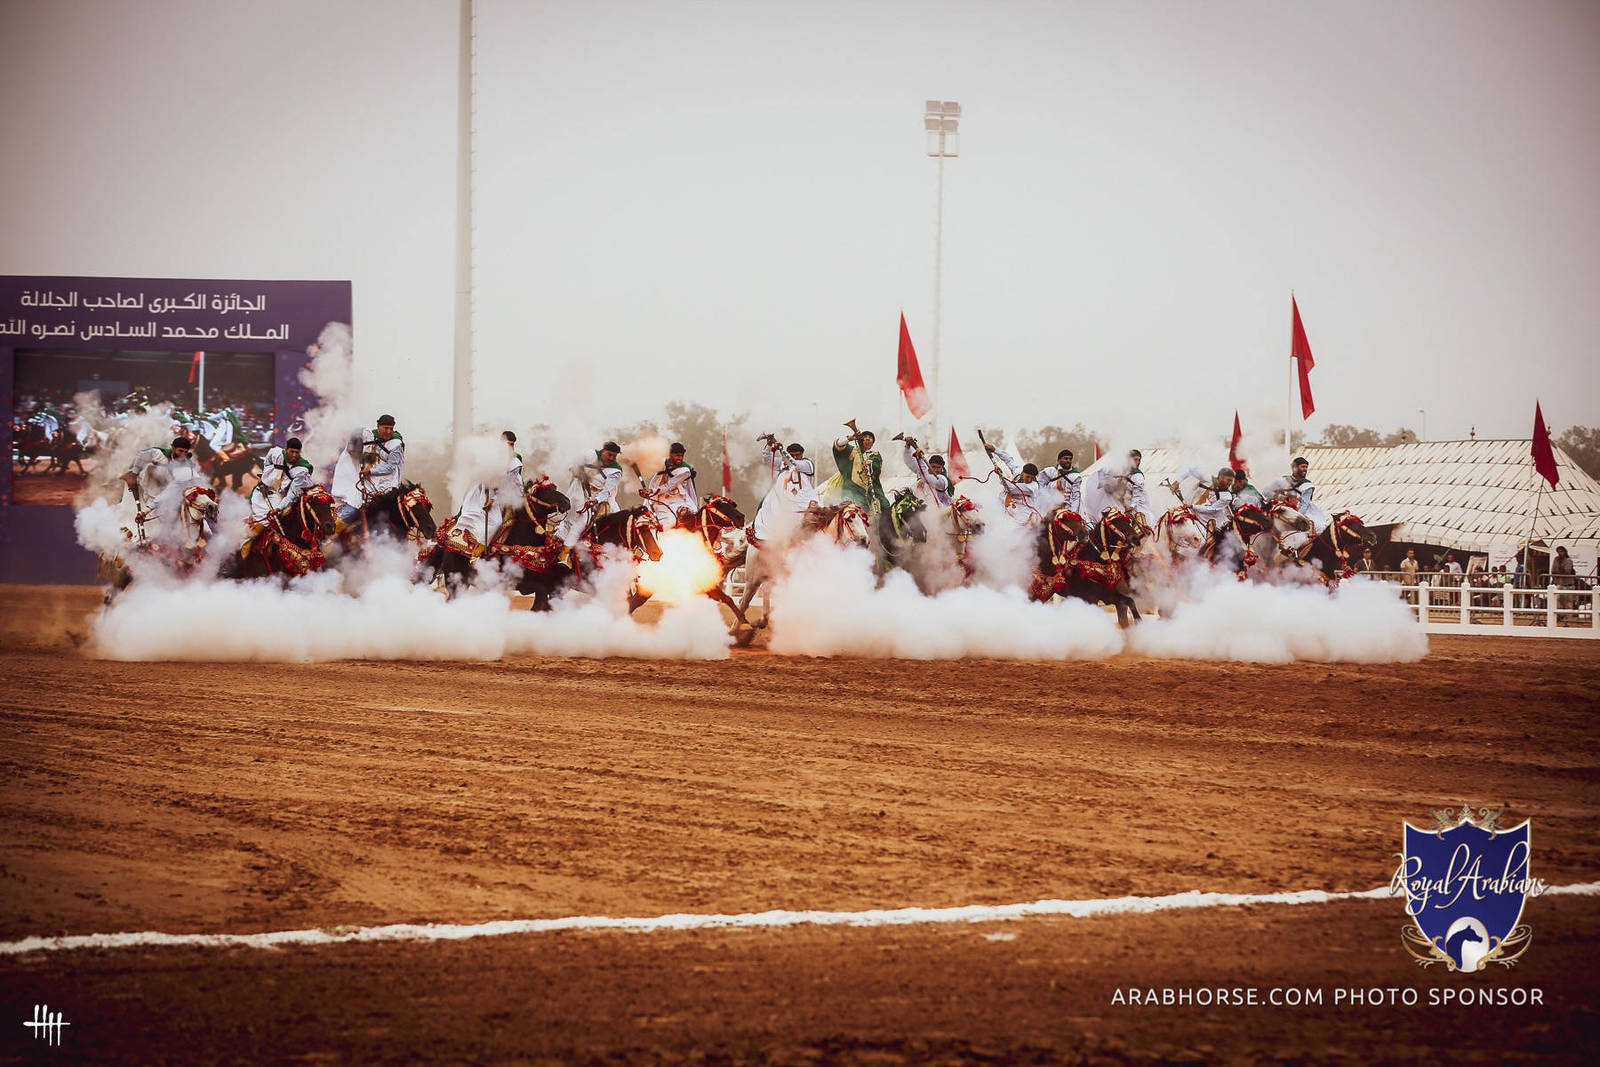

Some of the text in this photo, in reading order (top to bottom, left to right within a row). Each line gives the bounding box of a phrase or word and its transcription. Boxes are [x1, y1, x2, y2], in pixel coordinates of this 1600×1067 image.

[20, 290, 266, 315] الجائزة الكبرى لصاحب الجلالة
[31, 320, 75, 340] نصره
[80, 321, 157, 341] السادس
[161, 326, 219, 339] محمد
[223, 323, 289, 341] الملك
